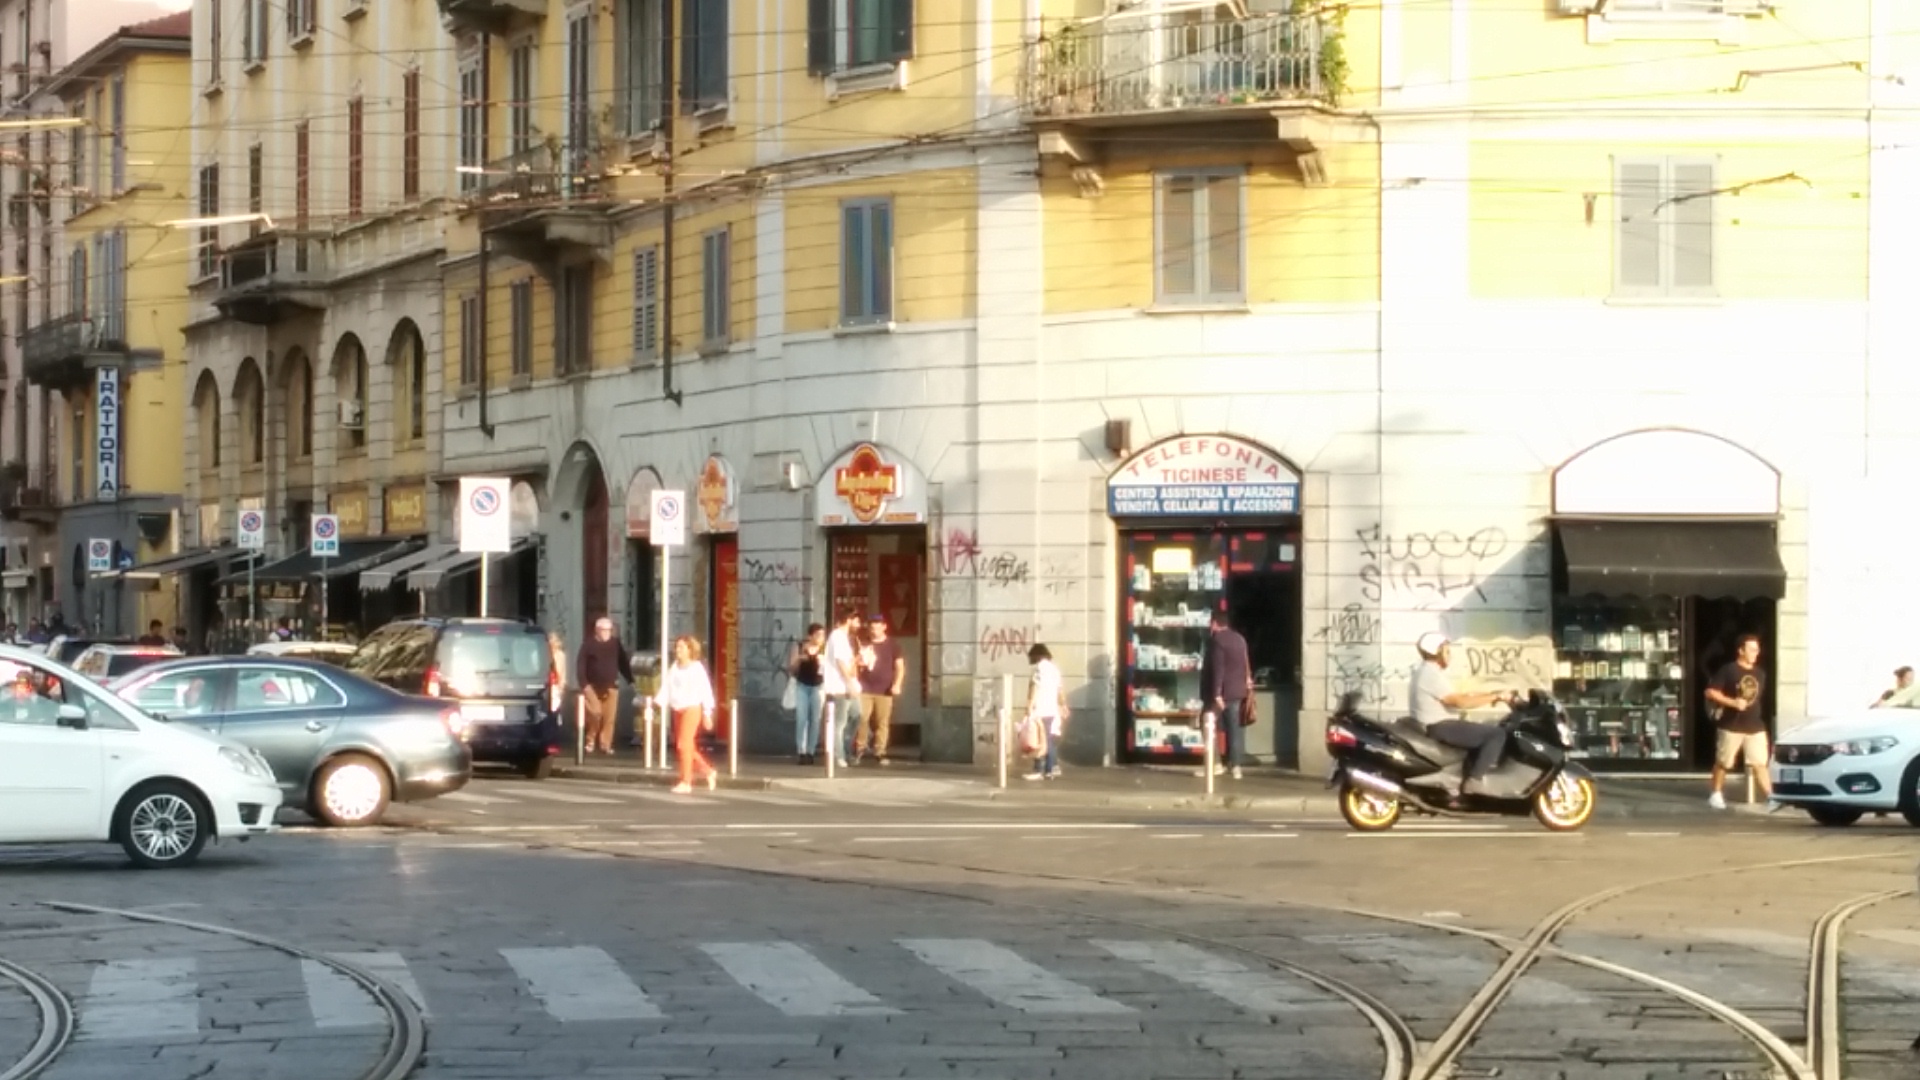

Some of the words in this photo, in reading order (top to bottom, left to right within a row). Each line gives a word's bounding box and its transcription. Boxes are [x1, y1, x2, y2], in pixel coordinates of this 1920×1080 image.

[99, 368, 115, 491] TRATTORIA
[1127, 439, 1280, 481] TELEFONIA
[1161, 468, 1247, 483] TICINESE
[1114, 487, 1157, 499] CENTRO
[1160, 486, 1224, 499] ASSISTENZA
[1227, 485, 1294, 498] RIPARAZIONI
[1114, 500, 1160, 513] VENDITA
[1163, 499, 1219, 512] CELLULARI
[1233, 499, 1292, 512] ACCESSORI
